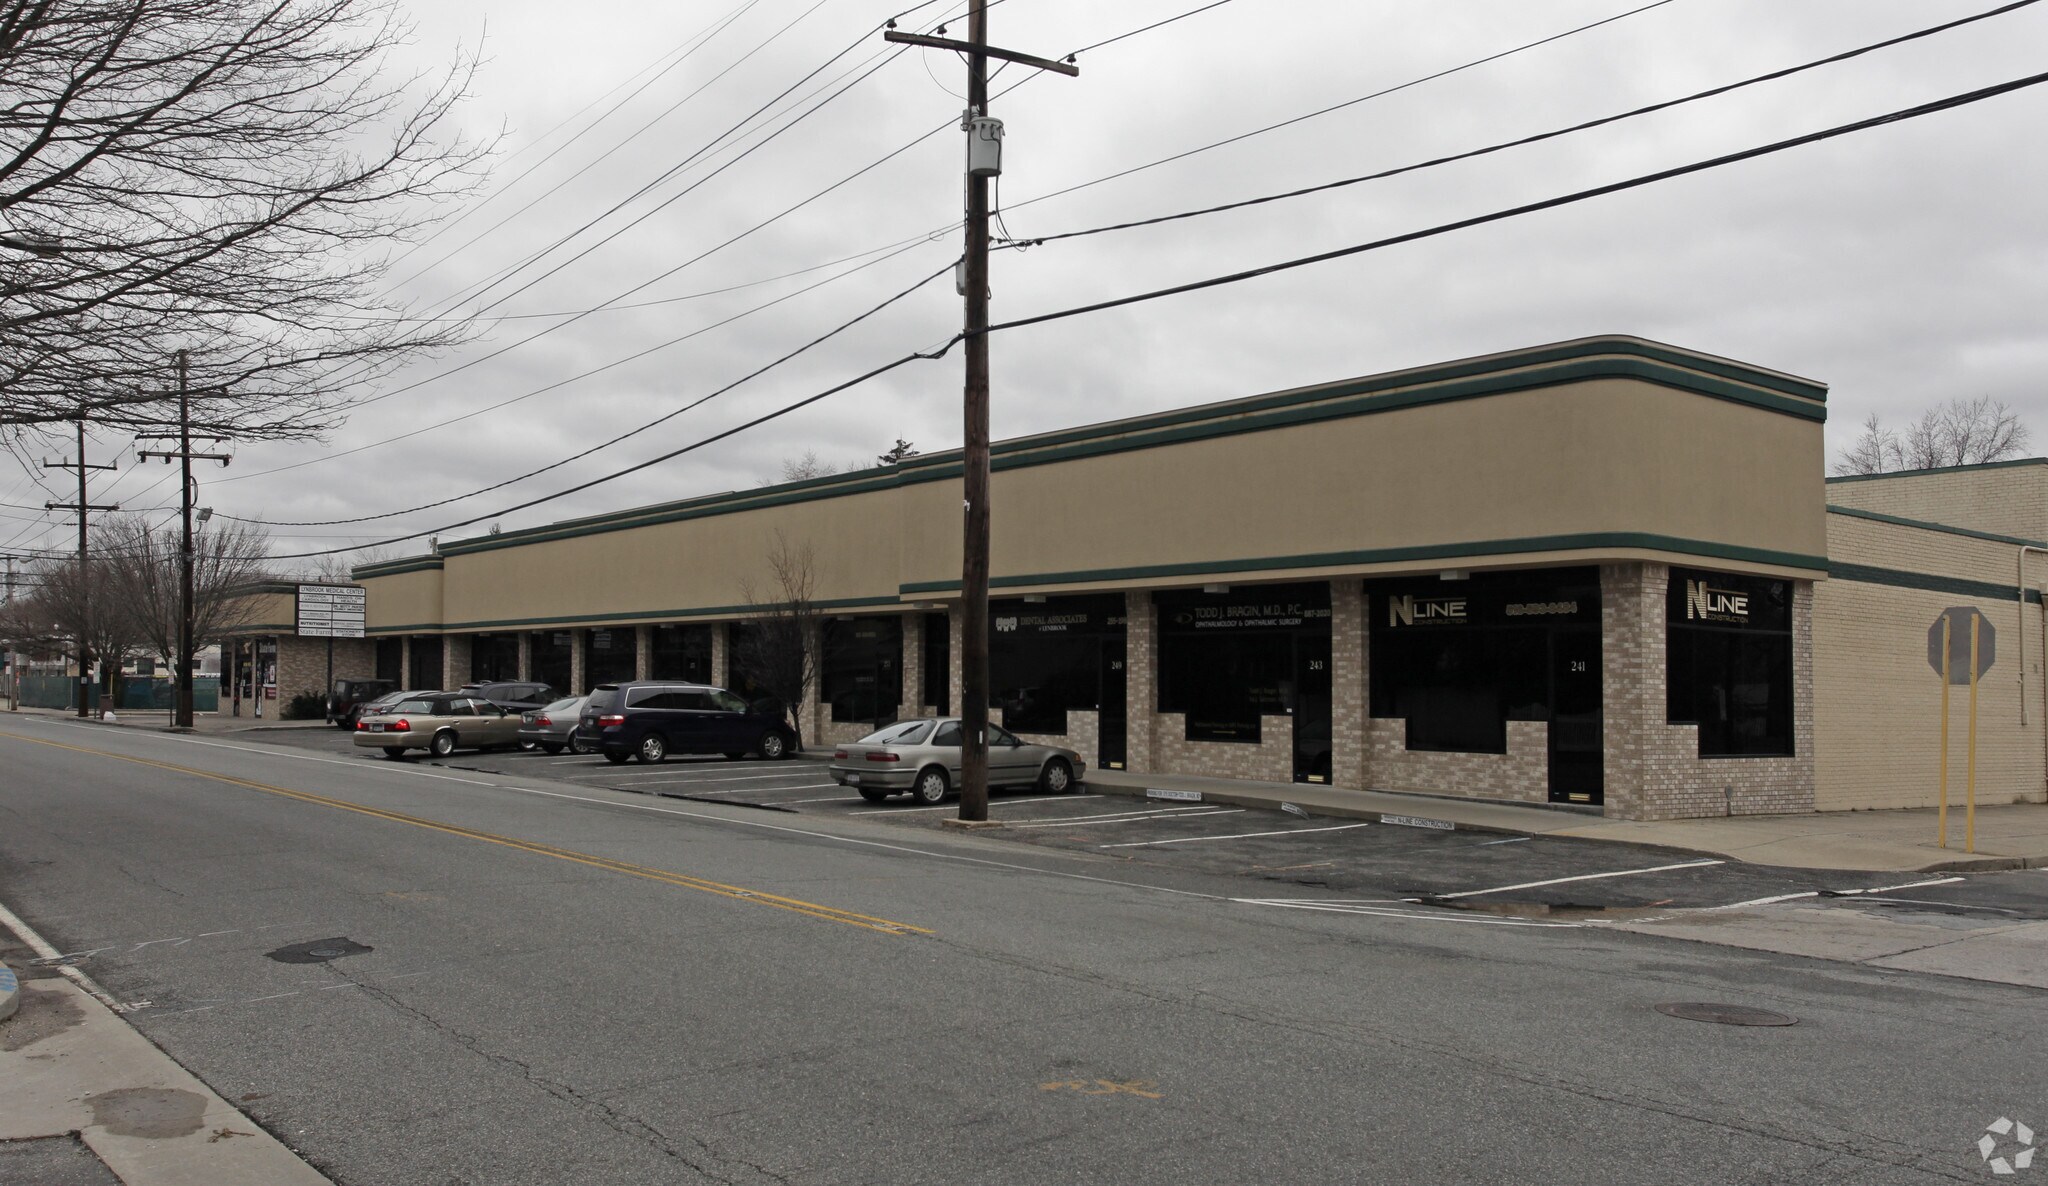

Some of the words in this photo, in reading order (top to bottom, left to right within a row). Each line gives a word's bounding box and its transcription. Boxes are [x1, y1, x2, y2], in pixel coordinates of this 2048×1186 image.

[1195, 607, 1218, 618] TODD
[1227, 605, 1261, 617] BRAGIN,
[1020, 616, 1046, 625] DENTAL
[1048, 614, 1087, 624] ASSOCIATES
[1279, 617, 1303, 626] SURGERY
[1708, 613, 1749, 624] CONSTRUCTION
[1310, 660, 1323, 670] 243
[1571, 660, 1586, 672] 241
[1415, 819, 1453, 829] CONSTRUCTION
